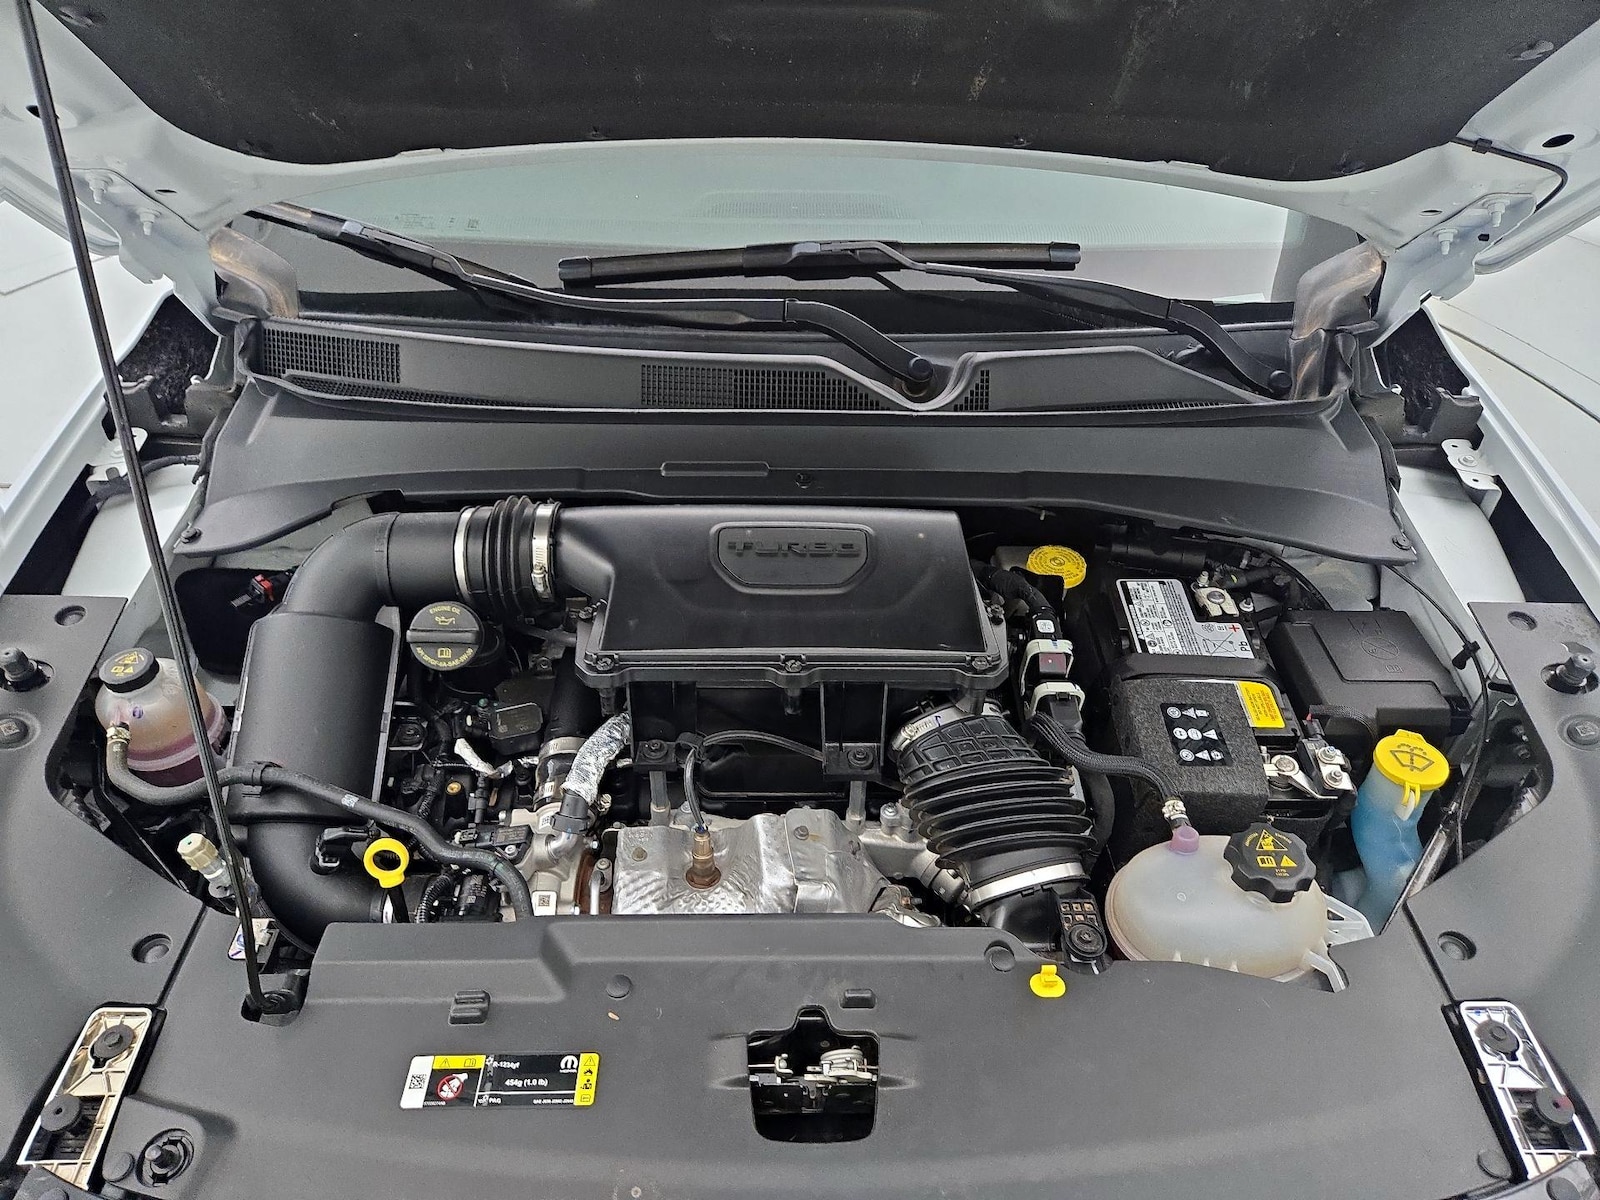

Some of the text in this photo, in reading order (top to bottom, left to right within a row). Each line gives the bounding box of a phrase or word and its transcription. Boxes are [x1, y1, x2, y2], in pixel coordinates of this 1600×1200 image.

[728, 541, 861, 558] TURBO
[429, 605, 451, 614] ENGINE
[1239, 640, 1251, 652] Pb
[493, 1060, 520, 1069] R-1234yf
[504, 1078, 523, 1088] 454g
[523, 1078, 537, 1087] (1.0
